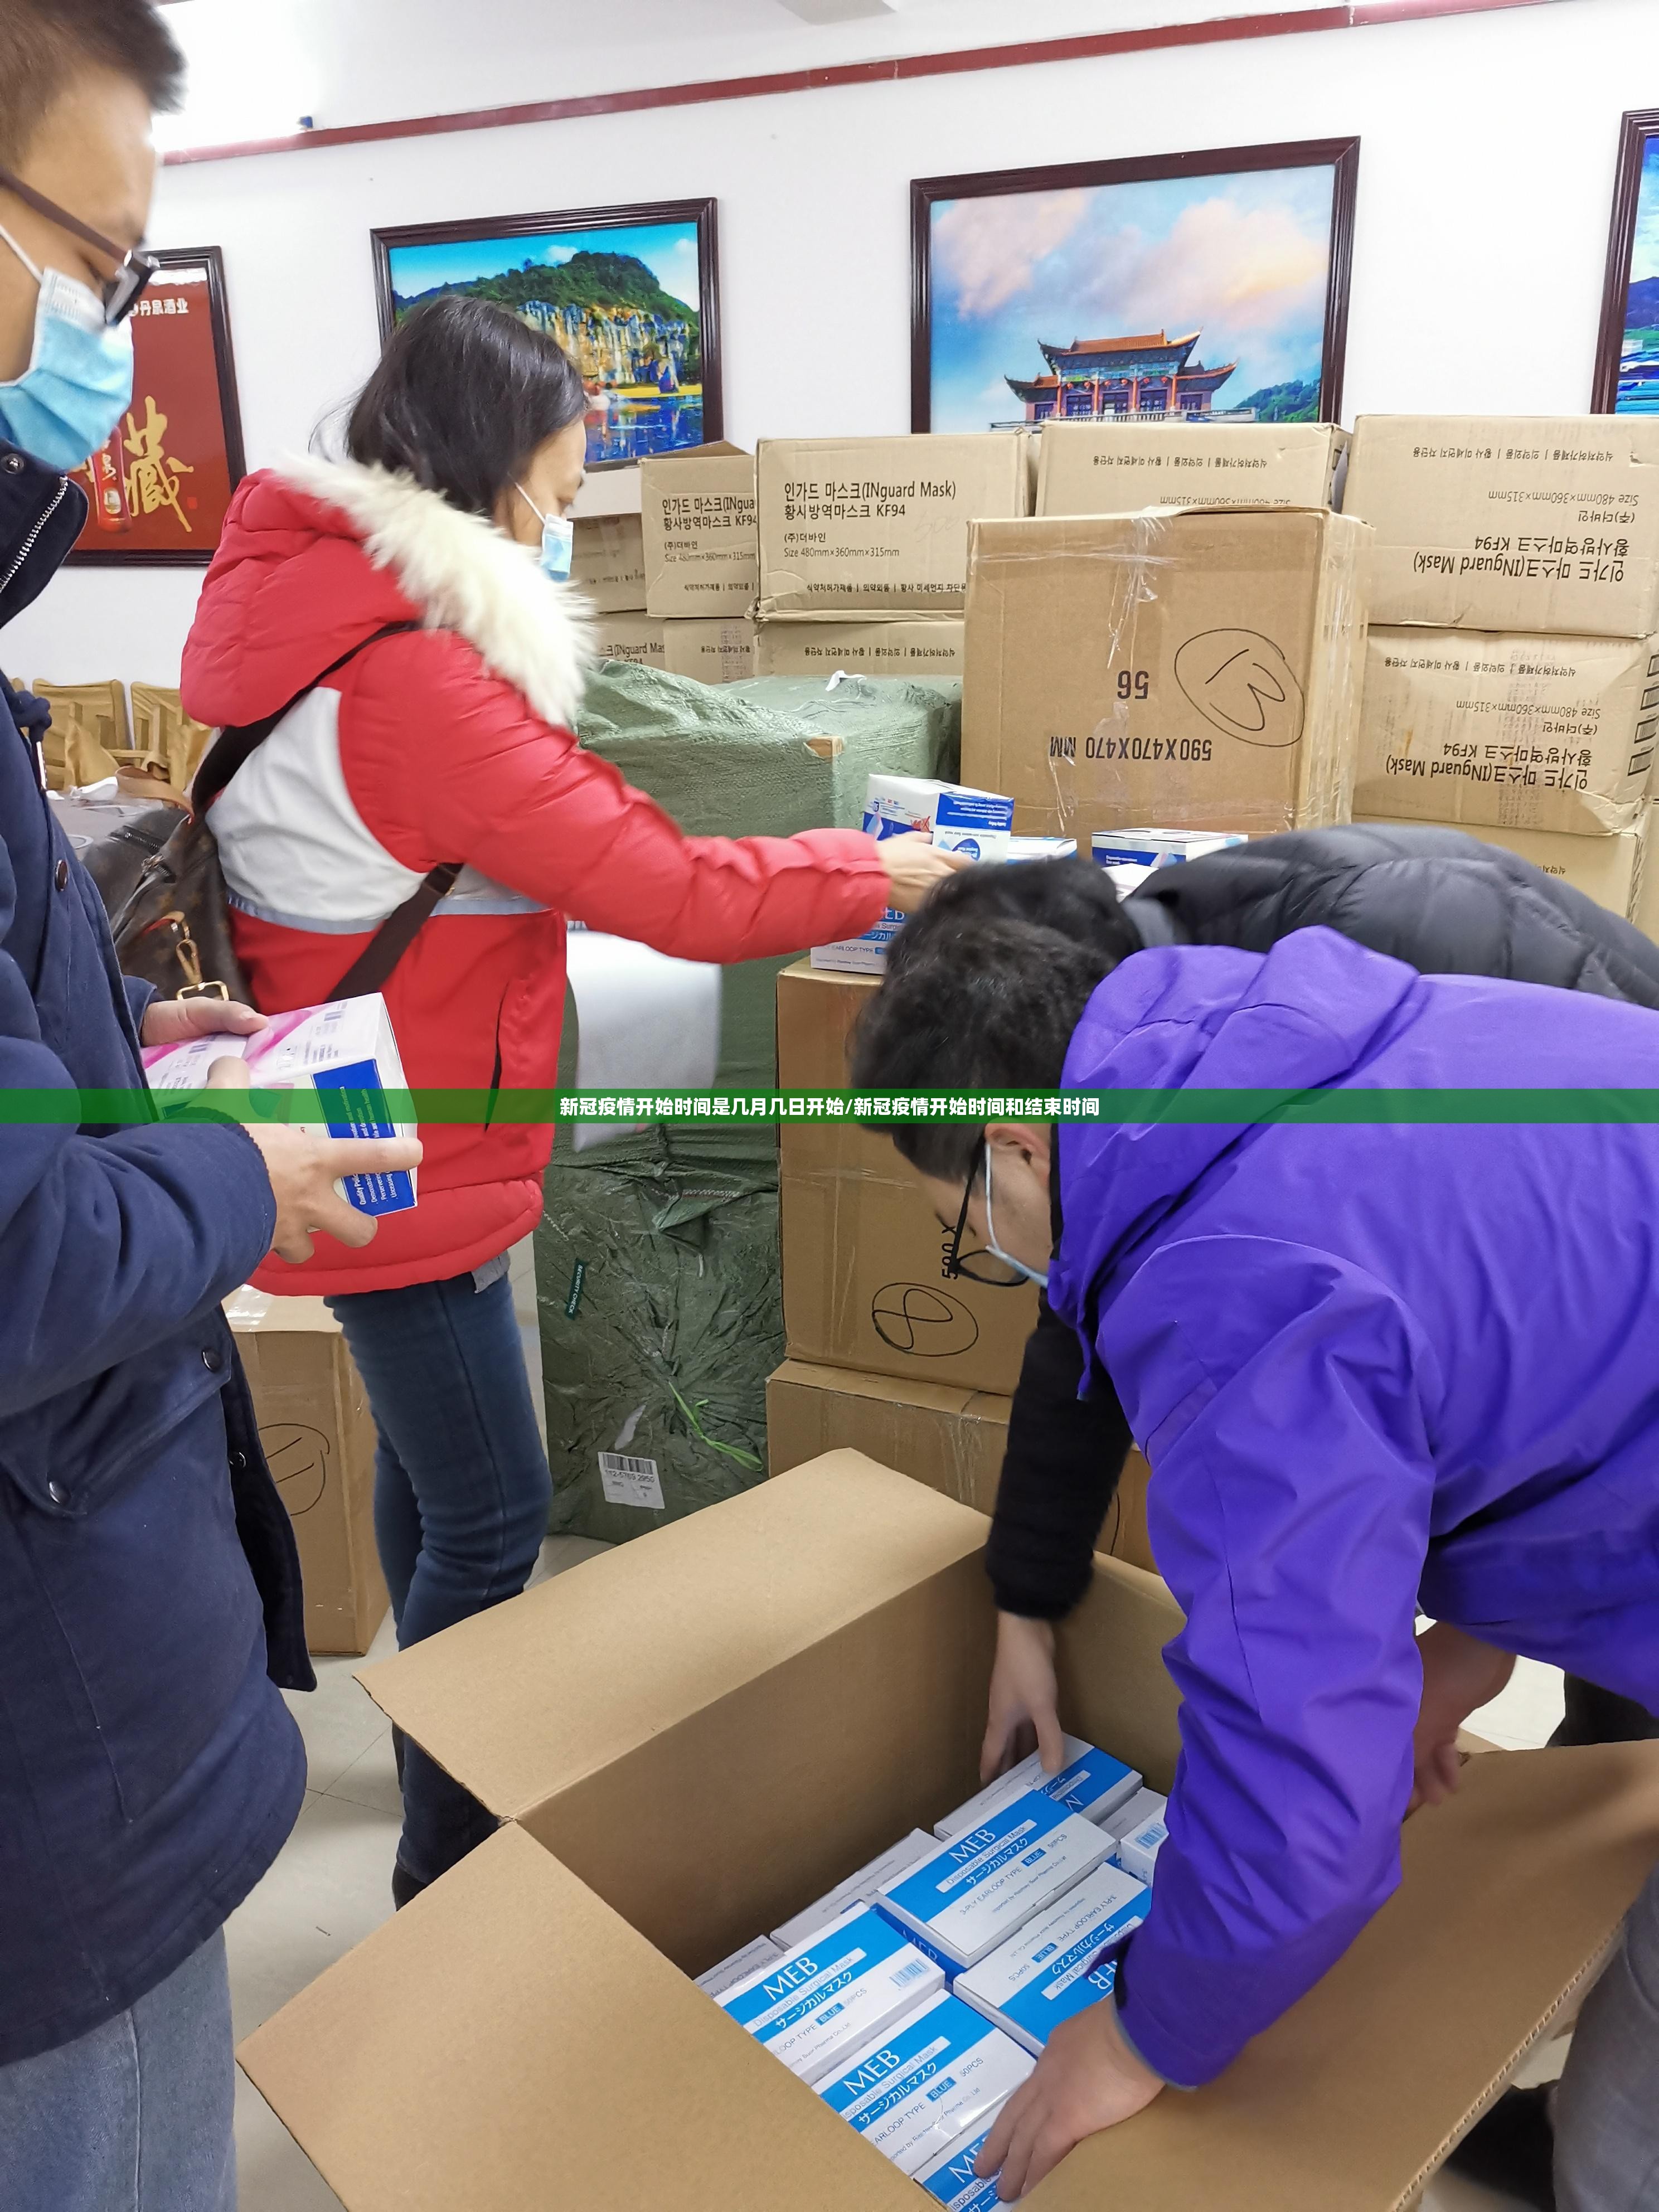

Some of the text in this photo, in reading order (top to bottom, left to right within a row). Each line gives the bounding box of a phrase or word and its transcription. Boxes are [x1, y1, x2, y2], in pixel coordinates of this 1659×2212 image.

[1215, 457, 1268, 469] 식약처허가제품
[1440, 448, 1473, 459] 미세먼지
[1476, 448, 1492, 459] 황사
[1506, 449, 1540, 460] 의약외품
[1553, 450, 1614, 462] 식약처허가제품
[784, 480, 956, 502] 인가드 마스크(INguard Mask)
[1619, 493, 1639, 506] Size
[662, 496, 755, 515] 인가드 마스크(INgua
[876, 505, 905, 517] KF94
[664, 516, 731, 531] 황사방역마스크
[1578, 510, 1636, 524] (주)더바인
[784, 533, 826, 543] (주)더바인
[1474, 536, 1629, 557] 황사방역마스크 KF94
[784, 547, 798, 557] Size
[1413, 551, 1624, 583] 인가드 마스크(INguard Mask)
[650, 643, 665, 653] Mas
[1410, 658, 1441, 671] 미세먼지
[1444, 661, 1460, 671] 황사
[1473, 662, 1505, 674] 의약외품
[1518, 664, 1576, 677] 식약처허가제품
[1117, 670, 1149, 700] 56
[1581, 706, 1601, 719] Size
[1542, 721, 1598, 736] (주)더바인
[1051, 736, 1213, 761] 590X470X470 MM
[1443, 743, 1592, 767] 황사방역마스크 KF94
[1386, 754, 1588, 790] 인가드 마스크(INguard Mask)
[352, 1173, 361, 1188] Polic
[567, 1293, 578, 1314] CHECK
[947, 1826, 1027, 1884] Disposable Surgical Mask
[949, 1829, 996, 1863] MEB
[966, 1837, 1028, 1885] サージカルマスク
[977, 1878, 1005, 1901] EARLOOP
[1005, 1867, 1022, 1880] TYPE
[1025, 1849, 1043, 1864] BLUE
[1059, 1928, 1076, 1942] TYPE
[1037, 1946, 1055, 1961] BLUE
[1052, 1923, 1115, 1975] サージカルマスク
[763, 1957, 818, 2001] MEB
[1054, 1972, 1076, 1991] Mask
[753, 1957, 853, 2027] Disposable Surgical Mask
[775, 1971, 852, 2029] サージカルマスク
[797, 2024, 817, 2040] TYPE
[819, 2006, 841, 2022] BLUE
[843, 1988, 867, 2006] 50PCS
[842, 2046, 938, 2119] isposable Surgical Mask
[843, 2050, 900, 2096] MEB
[858, 2062, 937, 2124] サージカルマスク
[904, 2102, 926, 2121] TYPE
[930, 2080, 953, 2099] BLUE
[960, 2058, 984, 2077] 50PCS
[890, 2146, 908, 2161] ported
[950, 2177, 991, 2211] isposable
